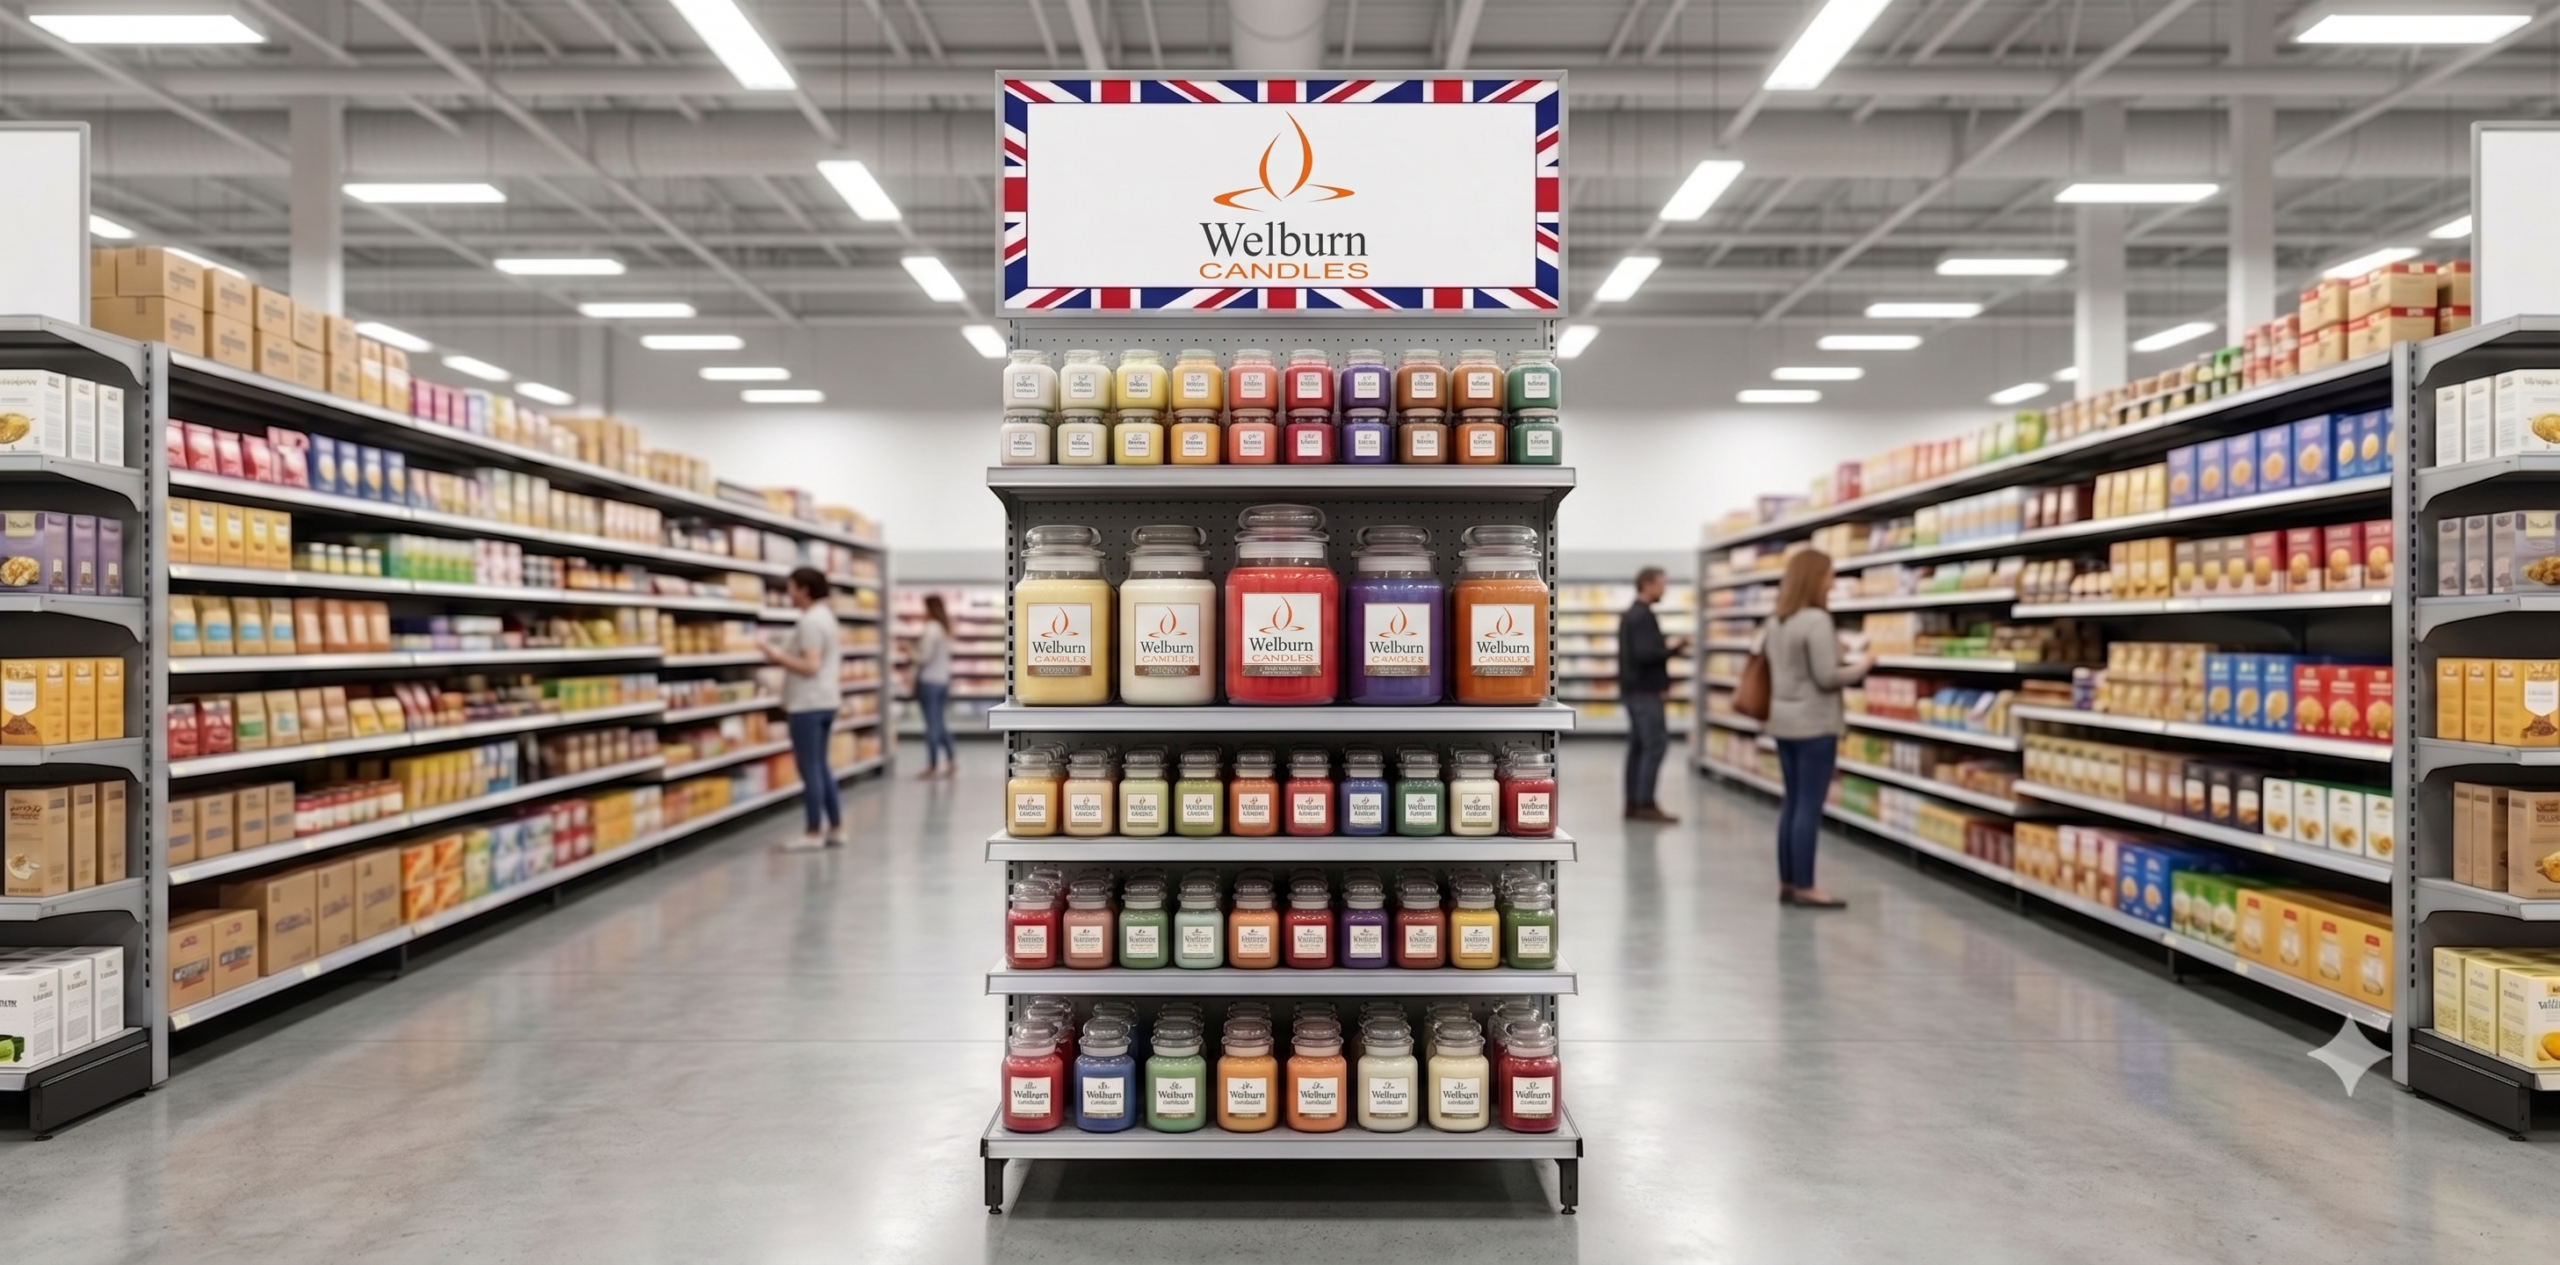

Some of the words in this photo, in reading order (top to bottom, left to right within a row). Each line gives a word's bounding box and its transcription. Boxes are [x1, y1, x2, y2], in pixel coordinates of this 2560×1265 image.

[1198, 221, 1369, 257] Welburn
[1199, 262, 1369, 279] CANDLES
[1032, 641, 1085, 653] Welburn
[1141, 640, 1193, 653] Welburn
[1249, 637, 1313, 651] Welburn
[1370, 641, 1423, 653] Welburn
[1477, 641, 1529, 653] Welburn
[1251, 654, 1314, 662] CANDLES
